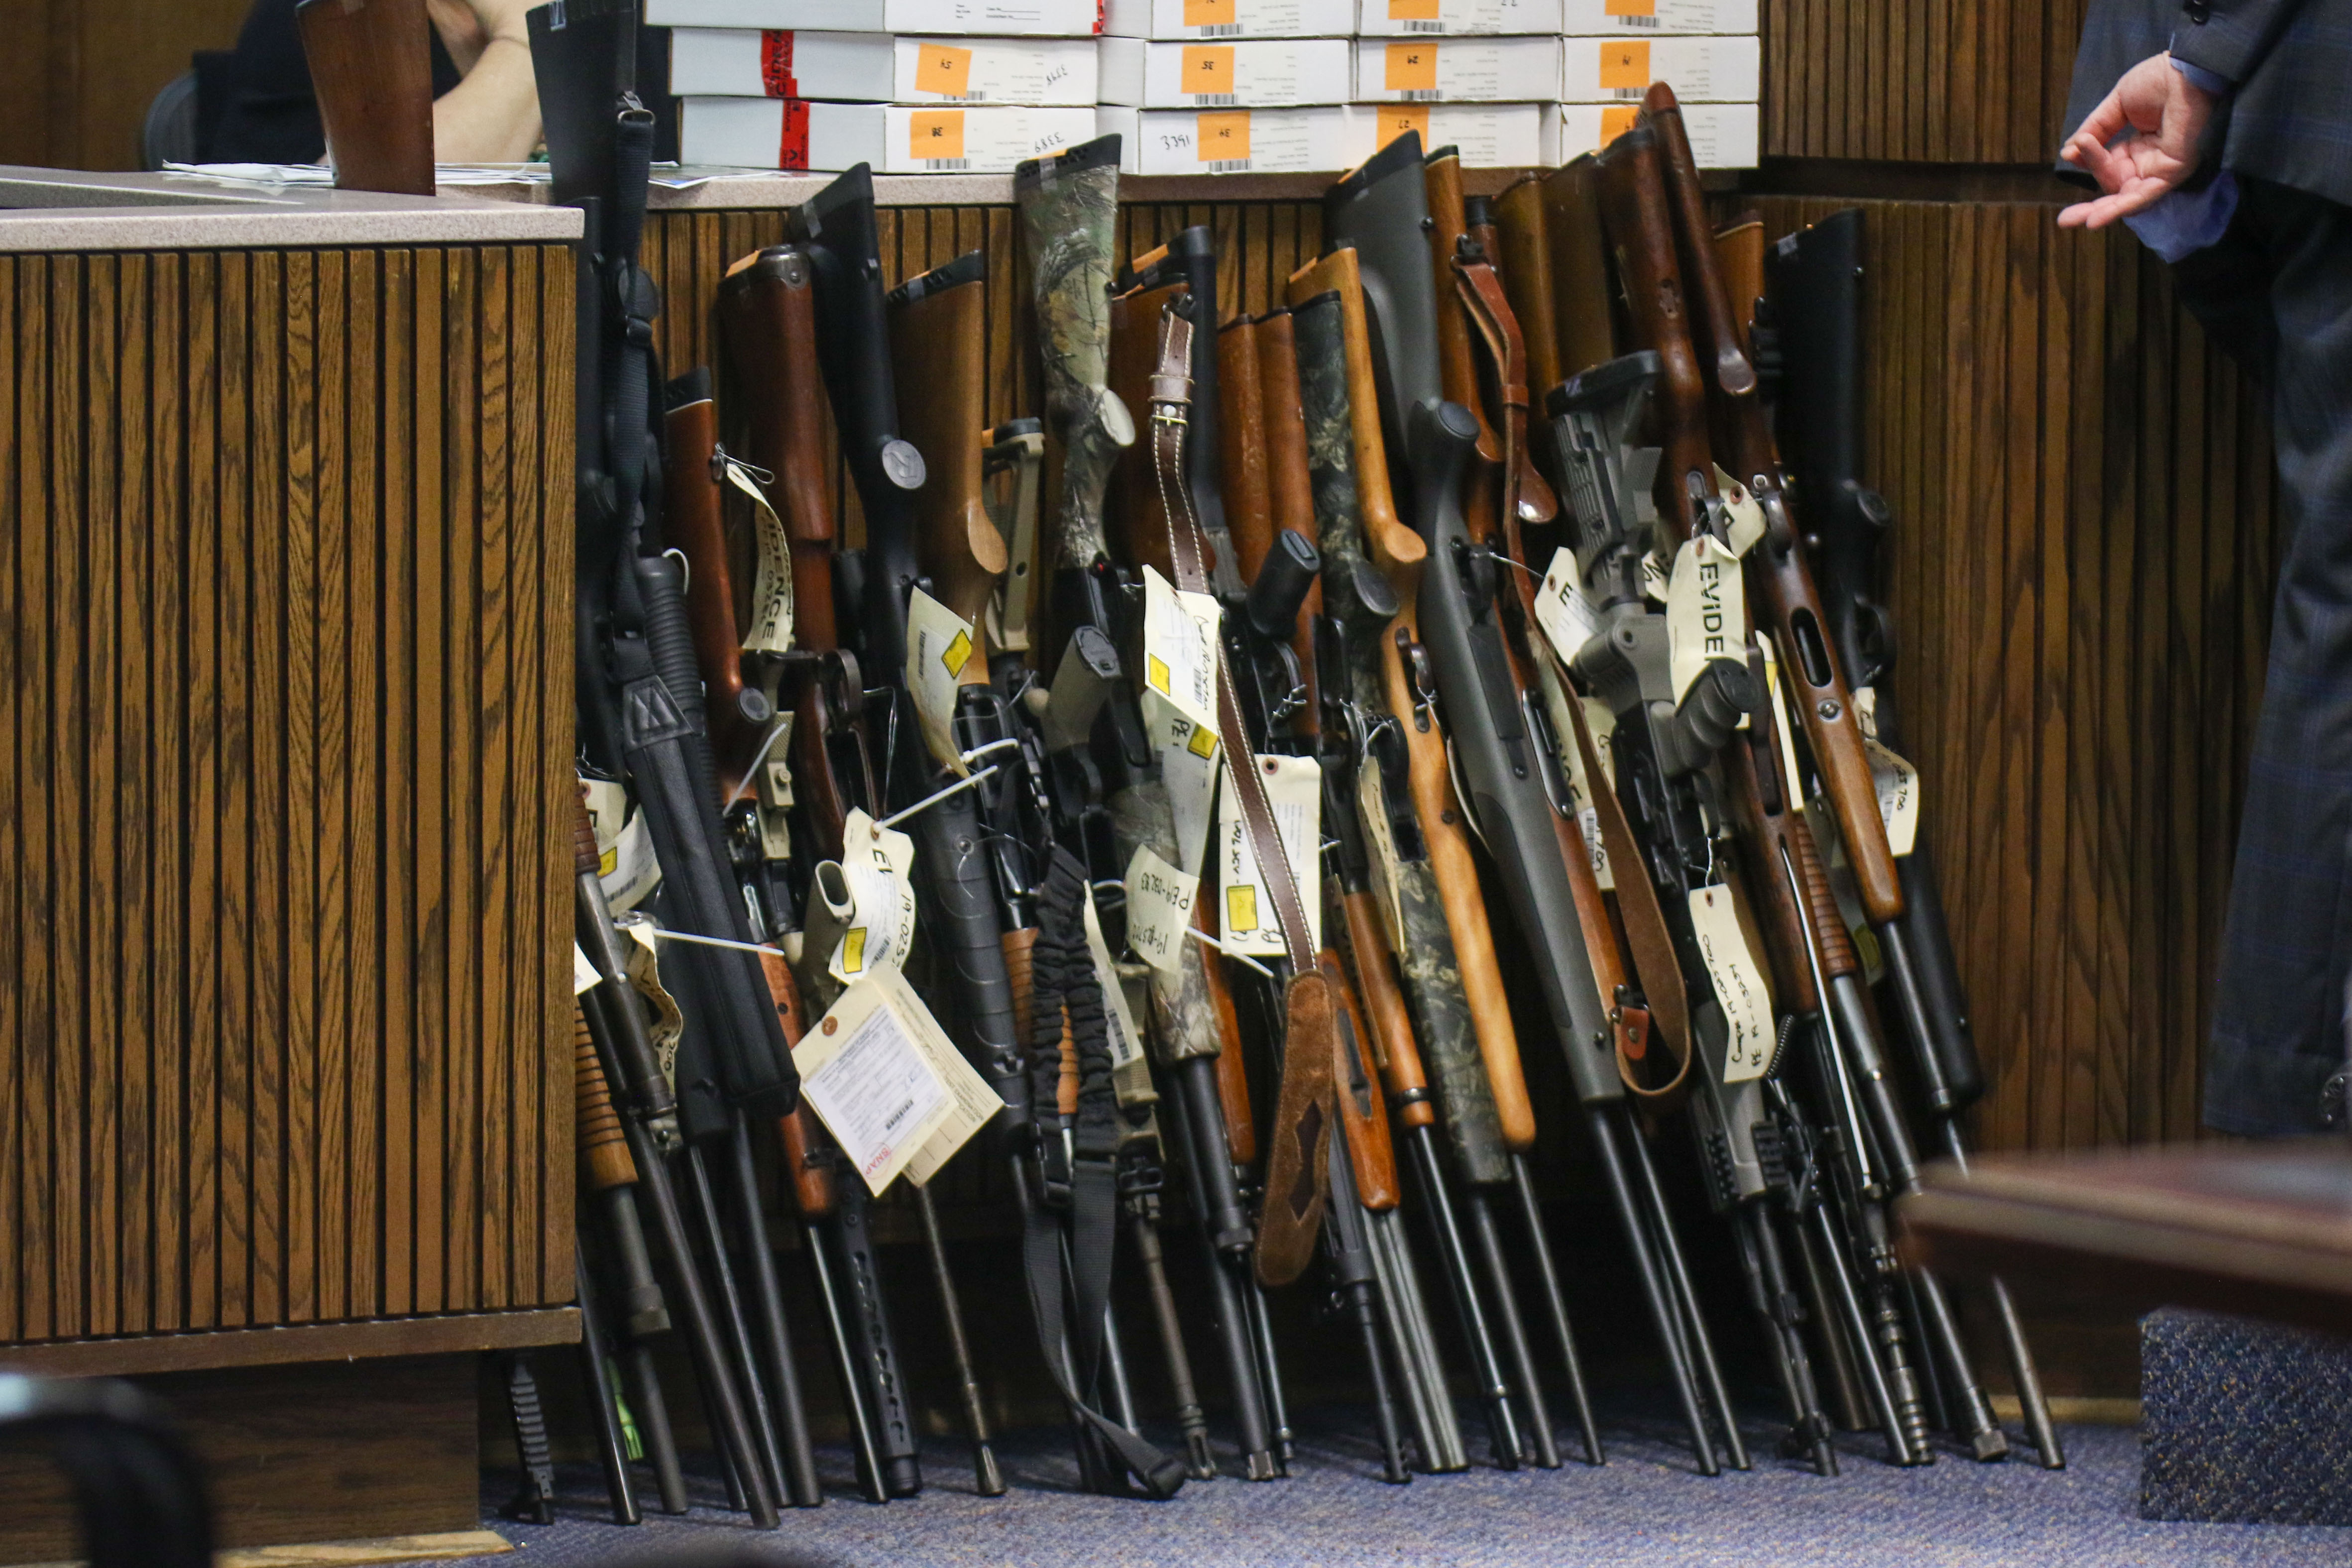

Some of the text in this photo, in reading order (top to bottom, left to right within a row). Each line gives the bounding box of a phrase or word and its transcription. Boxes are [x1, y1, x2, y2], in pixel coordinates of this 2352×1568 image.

[1201, 60, 1214, 70] 35
[1399, 120, 1410, 129] 27
[1034, 131, 1065, 154] 3389
[1160, 134, 1191, 150] 3391
[764, 507, 786, 640] VIDENCE
[864, 1144, 893, 1176] SNAP
